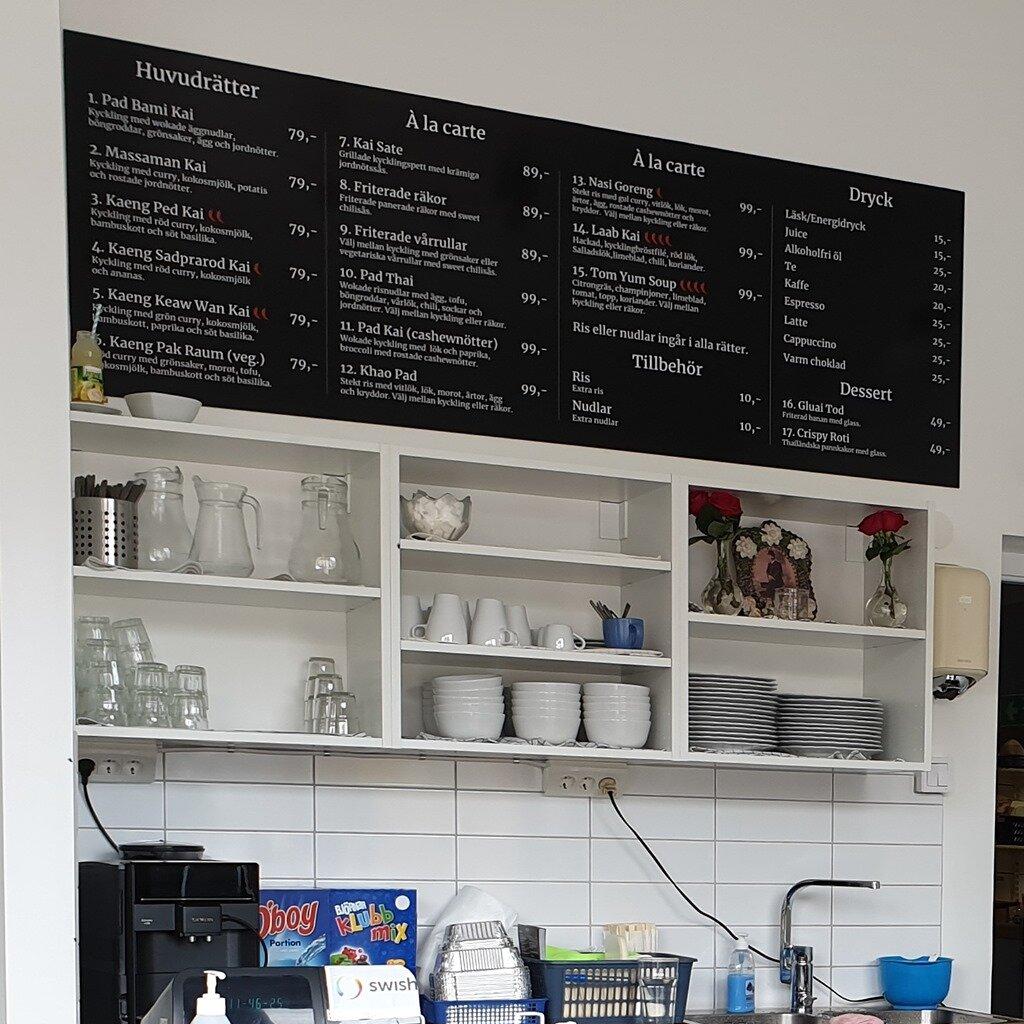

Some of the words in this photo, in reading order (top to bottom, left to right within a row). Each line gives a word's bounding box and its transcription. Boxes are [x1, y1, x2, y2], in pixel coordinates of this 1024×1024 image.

[135, 60, 260, 99] Huvudrätter
[88, 92, 98, 104] 1.
[101, 92, 128, 110] Pad
[131, 98, 168, 116] Bami
[171, 105, 195, 121] Kai
[405, 109, 420, 130] À
[422, 114, 439, 133] la
[442, 122, 486, 141] carte
[288, 127, 317, 144] 79,-
[338, 135, 350, 148] 7.
[353, 136, 374, 151] Kai
[376, 140, 403, 156] Sate
[89, 144, 102, 156] 2.
[105, 144, 181, 169] Massaman
[183, 158, 207, 174] Kai
[632, 148, 645, 168] À
[648, 152, 663, 171] la
[665, 160, 706, 178] carte
[522, 165, 550, 180] 89,-
[288, 175, 317, 191] 79,-
[572, 175, 587, 187] 13.
[588, 176, 613, 190] Nasi
[614, 180, 654, 199] Goreng
[339, 178, 351, 191] 8.
[353, 180, 412, 200] Friterade
[413, 190, 448, 206] räkor
[849, 186, 894, 209] Dryck
[90, 193, 102, 206] 3.
[106, 193, 151, 215] Kaeng
[153, 200, 179, 216] Ped
[181, 205, 205, 221] Kai
[522, 205, 550, 220] 89,-
[739, 202, 762, 215] 99,-
[785, 208, 866, 232] Läsk/Energidryck
[288, 223, 318, 238] 79,-
[339, 223, 352, 236] 9.
[354, 224, 412, 244] Friterade
[413, 232, 468, 252] vårrullar
[572, 222, 589, 235] 14.
[591, 223, 620, 239] Laab
[621, 228, 640, 242] Kai
[784, 226, 808, 239] Juice
[934, 234, 952, 246] 15,-
[91, 241, 105, 254] 4.
[108, 241, 153, 263] Kaeng
[155, 248, 226, 270] Sadprarod
[228, 258, 251, 274] Kai
[521, 248, 549, 263] 89,-
[738, 246, 763, 260] 99,-
[784, 243, 832, 260] Alkoholfri
[832, 250, 842, 262] öl
[934, 250, 952, 262] 15,-
[91, 255, 132, 271] Kyckling
[133, 262, 154, 272] med
[155, 264, 171, 274] röd
[171, 268, 199, 279] curry,
[200, 270, 251, 285] kokosmjölk
[91, 266, 109, 276] och
[110, 270, 145, 281] ananas.
[289, 266, 318, 282] 79,-
[784, 260, 797, 272] Te
[933, 266, 952, 278] 25,-
[339, 267, 357, 279] 10.
[360, 268, 383, 283] Pad
[385, 272, 414, 287] Thai
[572, 265, 588, 278] 15.
[589, 266, 618, 281] Tom
[619, 270, 646, 285] Yum
[648, 275, 677, 292] Soup
[784, 277, 810, 291] Kaffe
[738, 288, 763, 302] 99,-
[932, 283, 952, 294] 20,-
[92, 287, 105, 300] 5.
[108, 287, 152, 308] Kaeng
[154, 293, 193, 310] Keaw
[193, 299, 226, 315] Wan
[228, 303, 251, 318] Kai
[521, 292, 548, 306] 99,-
[784, 296, 826, 311] Espresso
[932, 301, 952, 313] 20,-
[289, 313, 318, 328] 79,-
[784, 315, 809, 328] Latte
[932, 318, 951, 330] 25,-
[340, 320, 355, 332] 11.
[357, 321, 381, 335] Pad
[383, 324, 404, 338] Kai
[406, 326, 498, 351] (cashewnötter)
[573, 321, 591, 334] Ris
[592, 323, 618, 338] eller
[619, 329, 656, 343] nudlar
[657, 332, 687, 348] ingår
[688, 336, 693, 348] i
[694, 337, 714, 350] alla
[716, 340, 749, 355] rätter.
[783, 333, 837, 350] Cappuccino
[932, 337, 952, 349] 25,-
[109, 335, 154, 355] Kaeng
[156, 341, 182, 355] Pak
[184, 344, 224, 361] Raum
[227, 349, 265, 367] (veg.)
[339, 343, 373, 355] broccoli
[374, 349, 392, 357] med
[392, 351, 423, 361] rostade
[423, 354, 479, 368] cashewnötter.
[520, 342, 547, 356] 99,-
[290, 357, 319, 373] 79,-
[631, 353, 704, 377] Tillbehör
[782, 352, 809, 365] Varm
[809, 356, 846, 370] choklad
[932, 355, 951, 366] 25,-
[340, 363, 357, 375] 12.
[360, 364, 392, 379] Khao
[394, 368, 418, 382] Pad
[572, 370, 591, 384] Ris
[931, 373, 950, 385] 25,-
[521, 383, 547, 397] 99,-
[572, 384, 593, 394] Extra
[593, 386, 604, 395] ris
[840, 381, 893, 402] Dessert
[572, 399, 613, 415] Nudlar
[739, 392, 762, 406] 10,-
[782, 398, 796, 410] 16.
[797, 400, 824, 413] Gluai
[824, 403, 845, 416] Tod
[572, 413, 593, 424] Extra
[593, 417, 619, 427] nudlar
[782, 411, 808, 421] Friterad
[828, 417, 843, 425] med
[930, 416, 951, 429] 49,-
[739, 421, 762, 435] 10,-
[782, 427, 795, 438] 17.
[796, 427, 829, 443] Crispy
[829, 431, 850, 444] Roti
[929, 443, 951, 456] 49,-
[269, 938, 302, 948] Portion
[369, 977, 418, 993] swish
